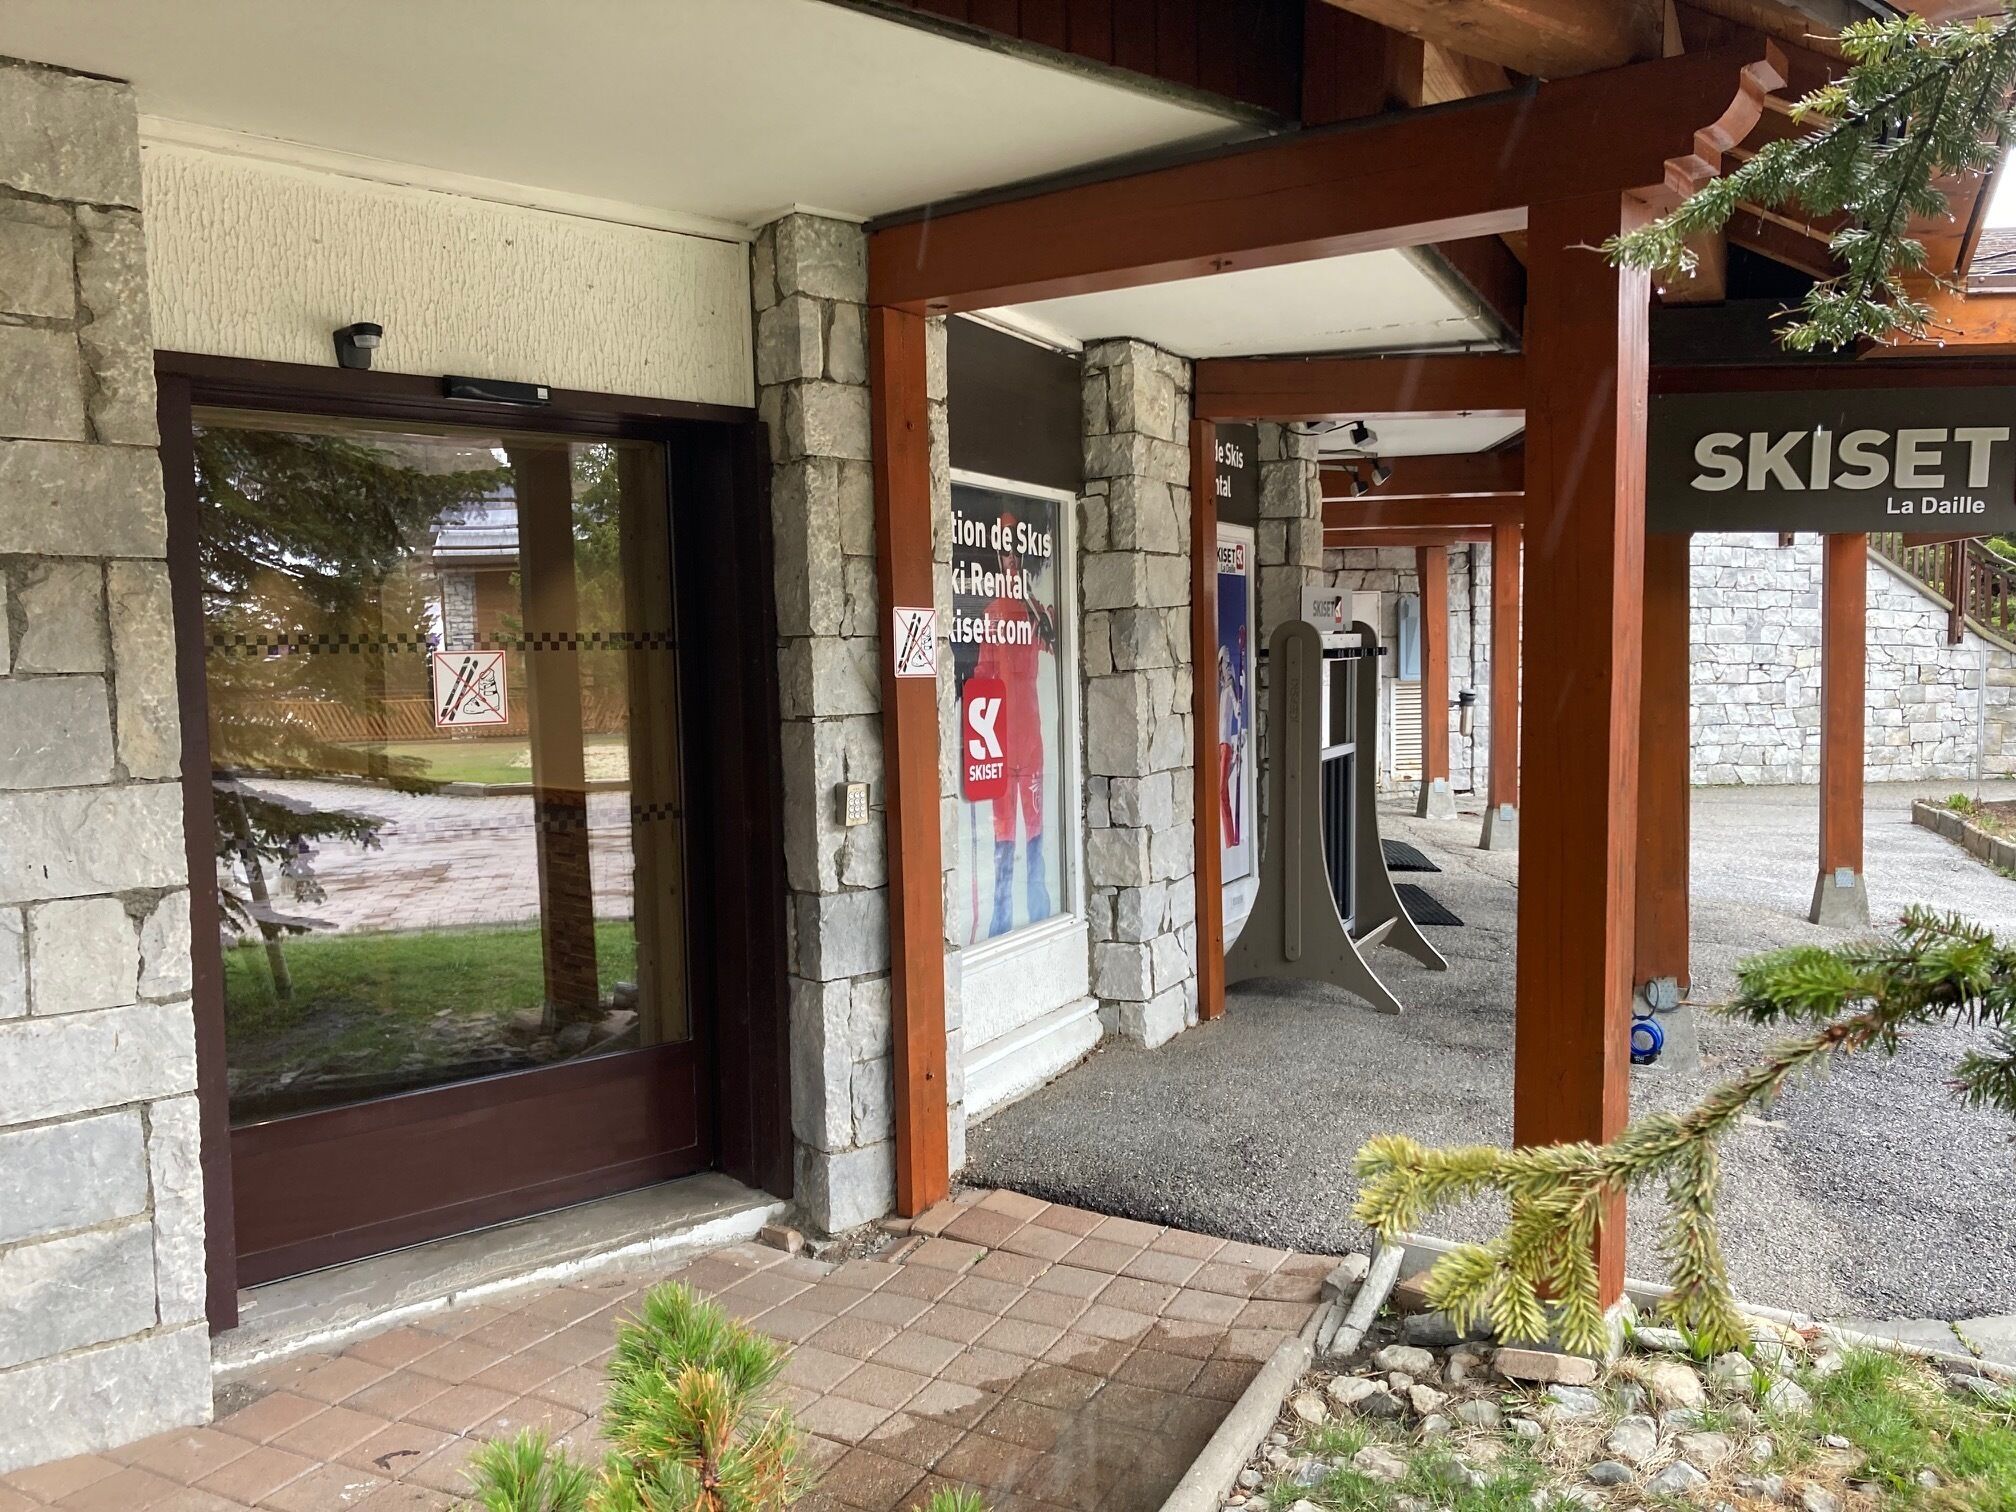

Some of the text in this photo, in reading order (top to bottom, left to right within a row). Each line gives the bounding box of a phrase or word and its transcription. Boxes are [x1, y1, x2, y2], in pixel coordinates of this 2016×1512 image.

[1225, 443, 1243, 468] Skis
[1690, 427, 2010, 492] SKISET
[1886, 496, 1986, 514] La Daille
[951, 510, 986, 548] tion
[991, 517, 1013, 552] de
[970, 562, 1030, 600] Rental
[969, 763, 1004, 782] SKISET
